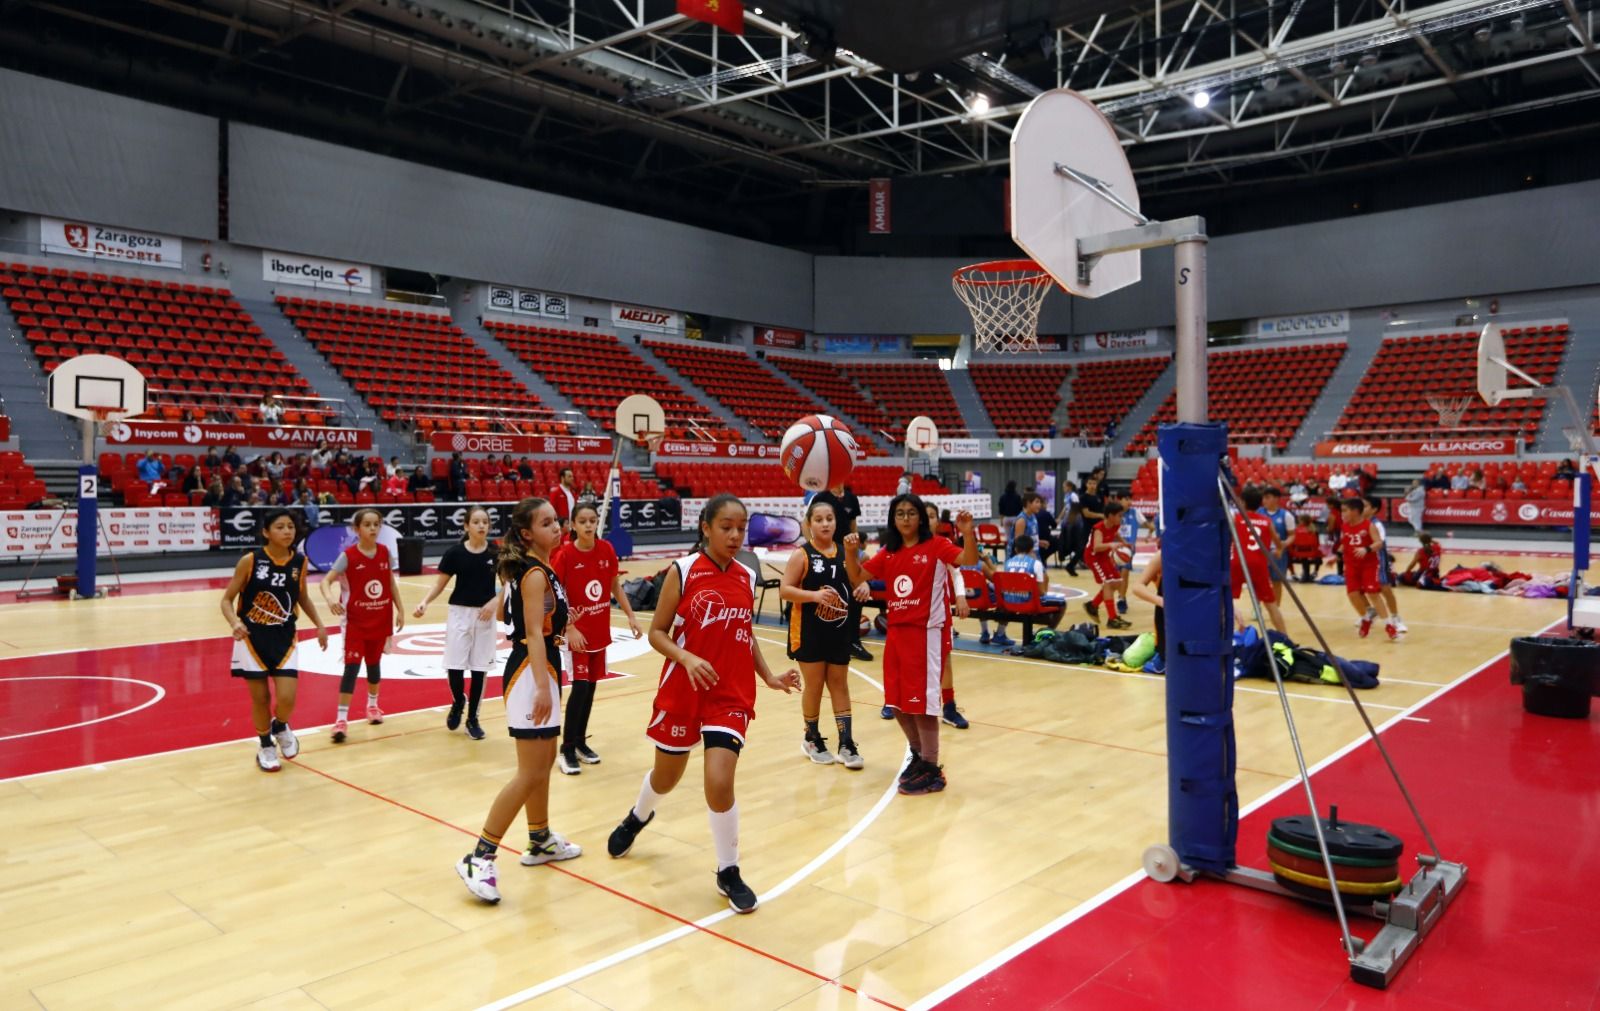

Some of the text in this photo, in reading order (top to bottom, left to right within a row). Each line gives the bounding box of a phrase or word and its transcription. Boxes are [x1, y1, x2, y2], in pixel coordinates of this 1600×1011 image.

[875, 191, 886, 231] AMBAR
[95, 227, 162, 248] Zaragoza
[271, 258, 334, 281] iberCaja
[1178, 267, 1191, 285] S
[291, 430, 358, 443] ANAGAN
[467, 437, 513, 452] ORBE
[1018, 439, 1045, 454] 30
[1419, 441, 1505, 452] ALEJANDRO
[84, 479, 95, 494] 2
[1349, 534, 1362, 545] 23
[271, 572, 287, 587] 22
[700, 600, 752, 630] Lupus
[735, 628, 749, 643] 85
[671, 725, 687, 737] 85
